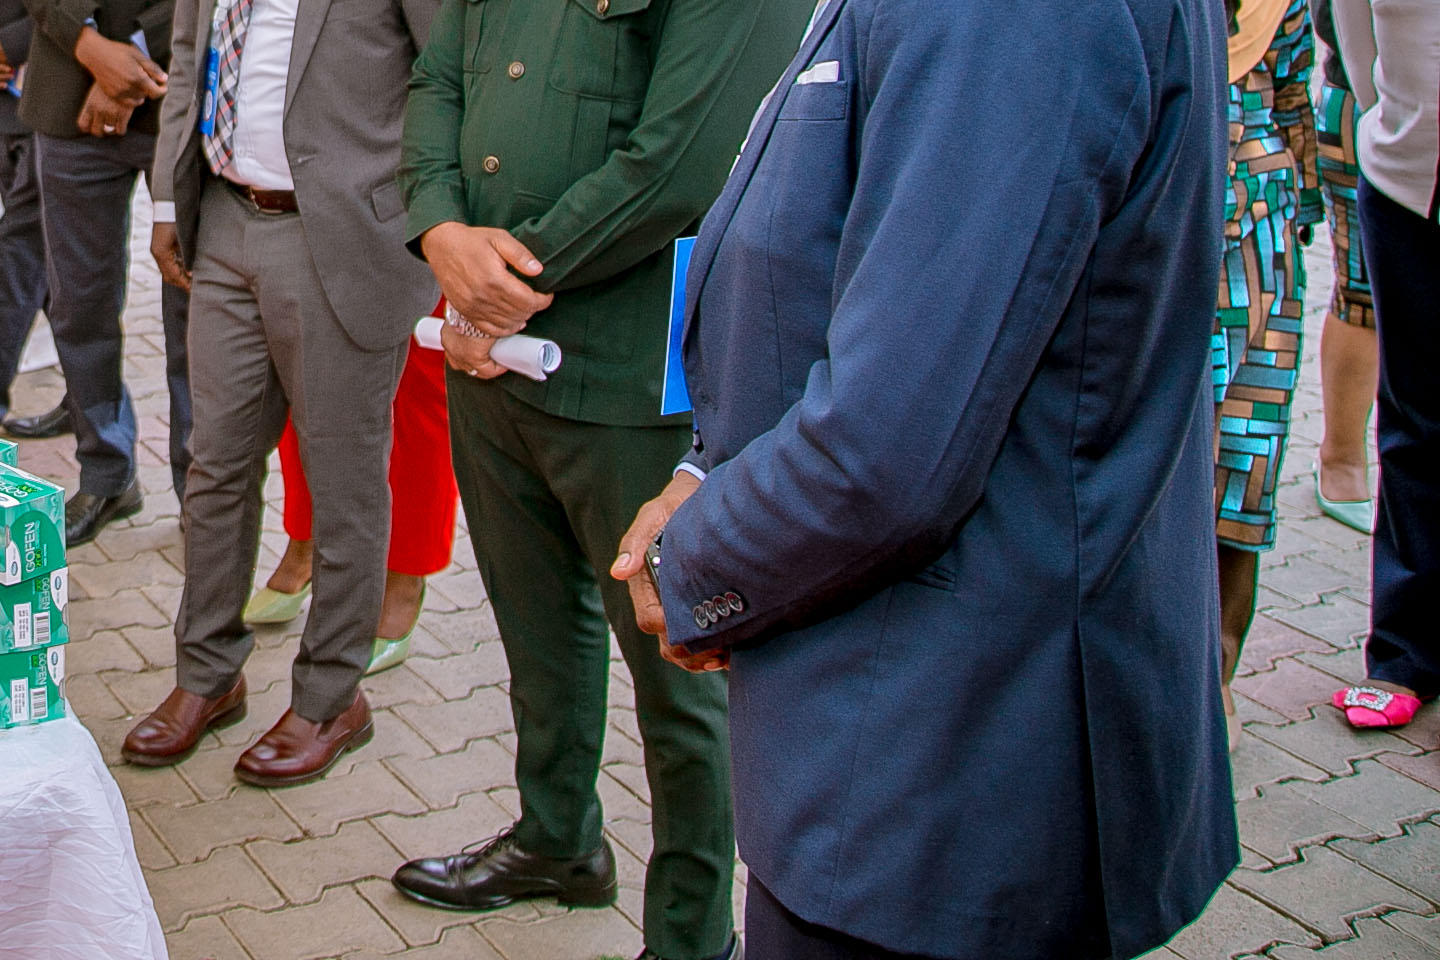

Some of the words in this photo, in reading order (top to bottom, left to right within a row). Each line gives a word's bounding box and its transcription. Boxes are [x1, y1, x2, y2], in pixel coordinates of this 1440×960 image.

[24, 521, 35, 572] GOFEN
[41, 578, 50, 610] GOFEN
[38, 653, 47, 685] GOFEN
